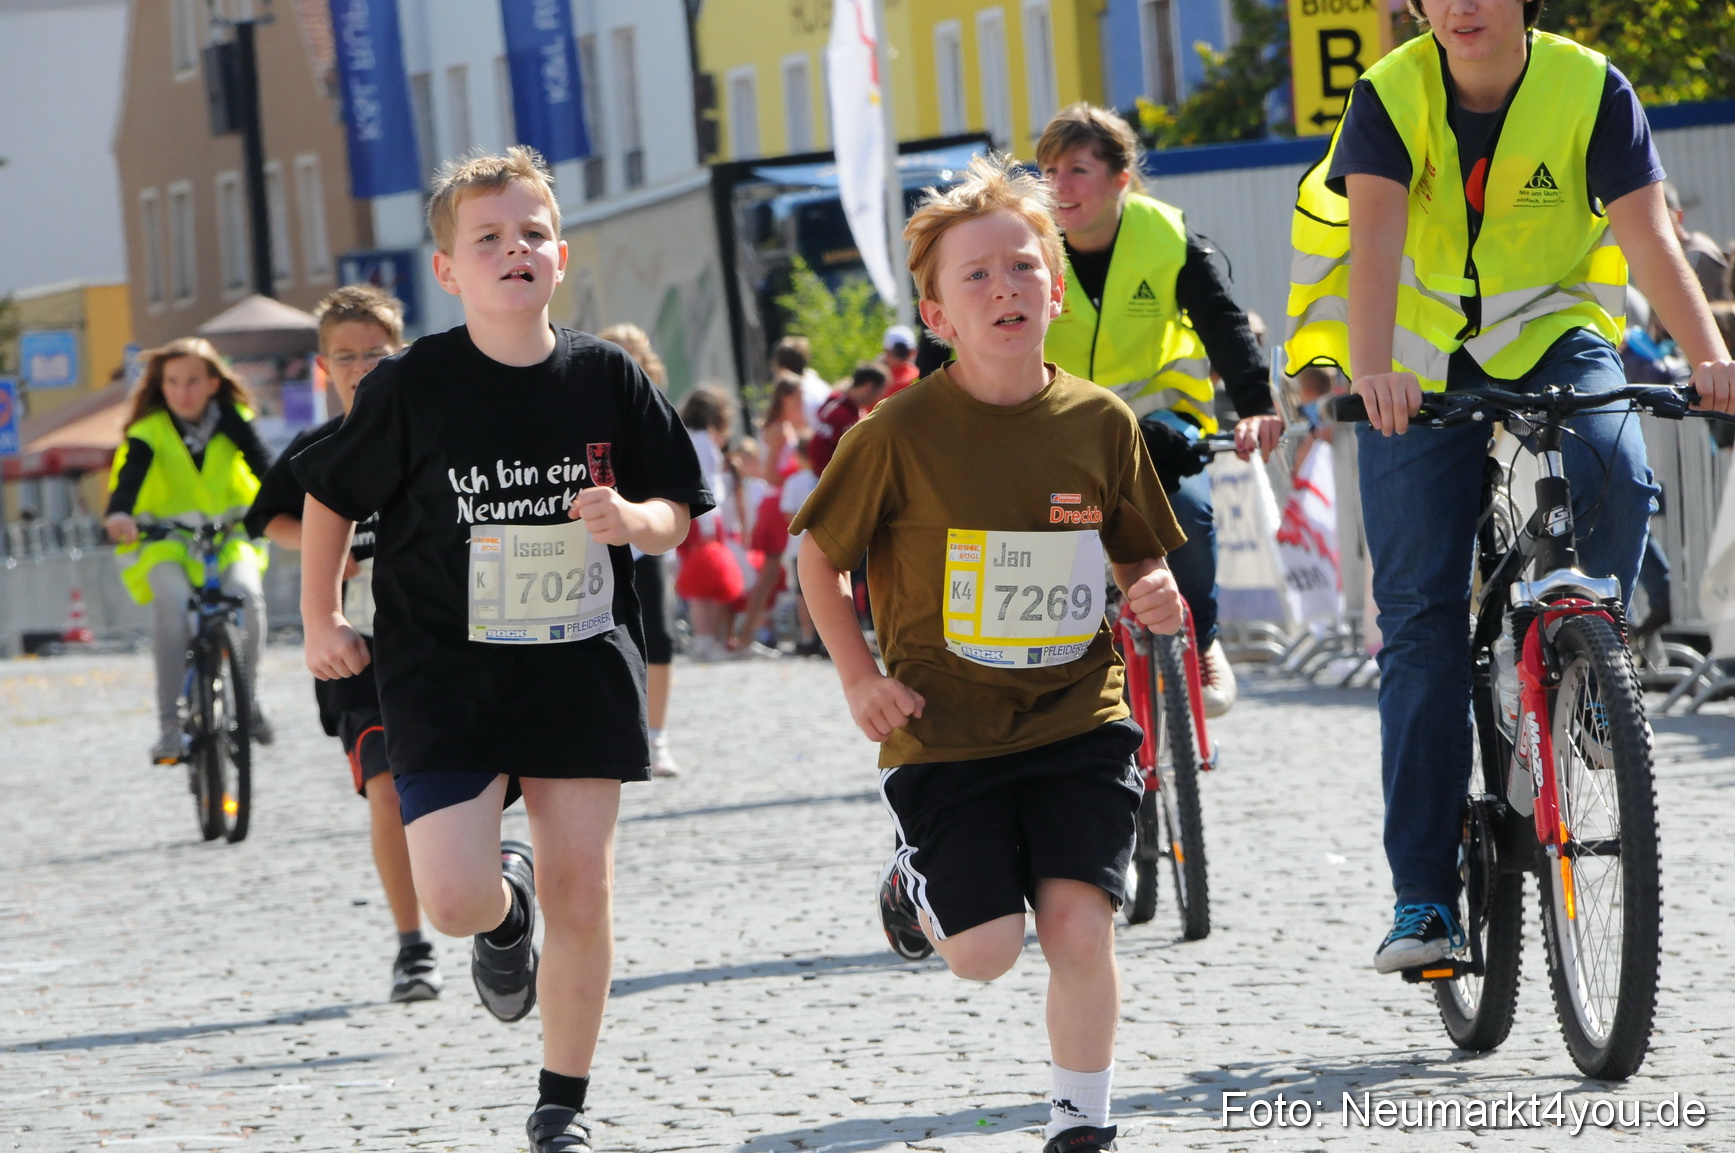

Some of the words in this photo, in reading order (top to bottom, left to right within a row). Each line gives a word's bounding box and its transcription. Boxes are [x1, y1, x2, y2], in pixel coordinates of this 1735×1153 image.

[1319, 29, 1365, 97] B
[448, 465, 489, 494] Ich
[496, 459, 539, 489] bin
[546, 457, 587, 486] ein
[513, 534, 565, 558] Isaac
[992, 541, 1032, 568] Jan
[515, 562, 604, 605] 7028
[951, 580, 972, 601] K4
[994, 583, 1093, 622] 7269
[566, 611, 611, 633] PFLEIDERER
[960, 645, 1004, 661] BOCK
